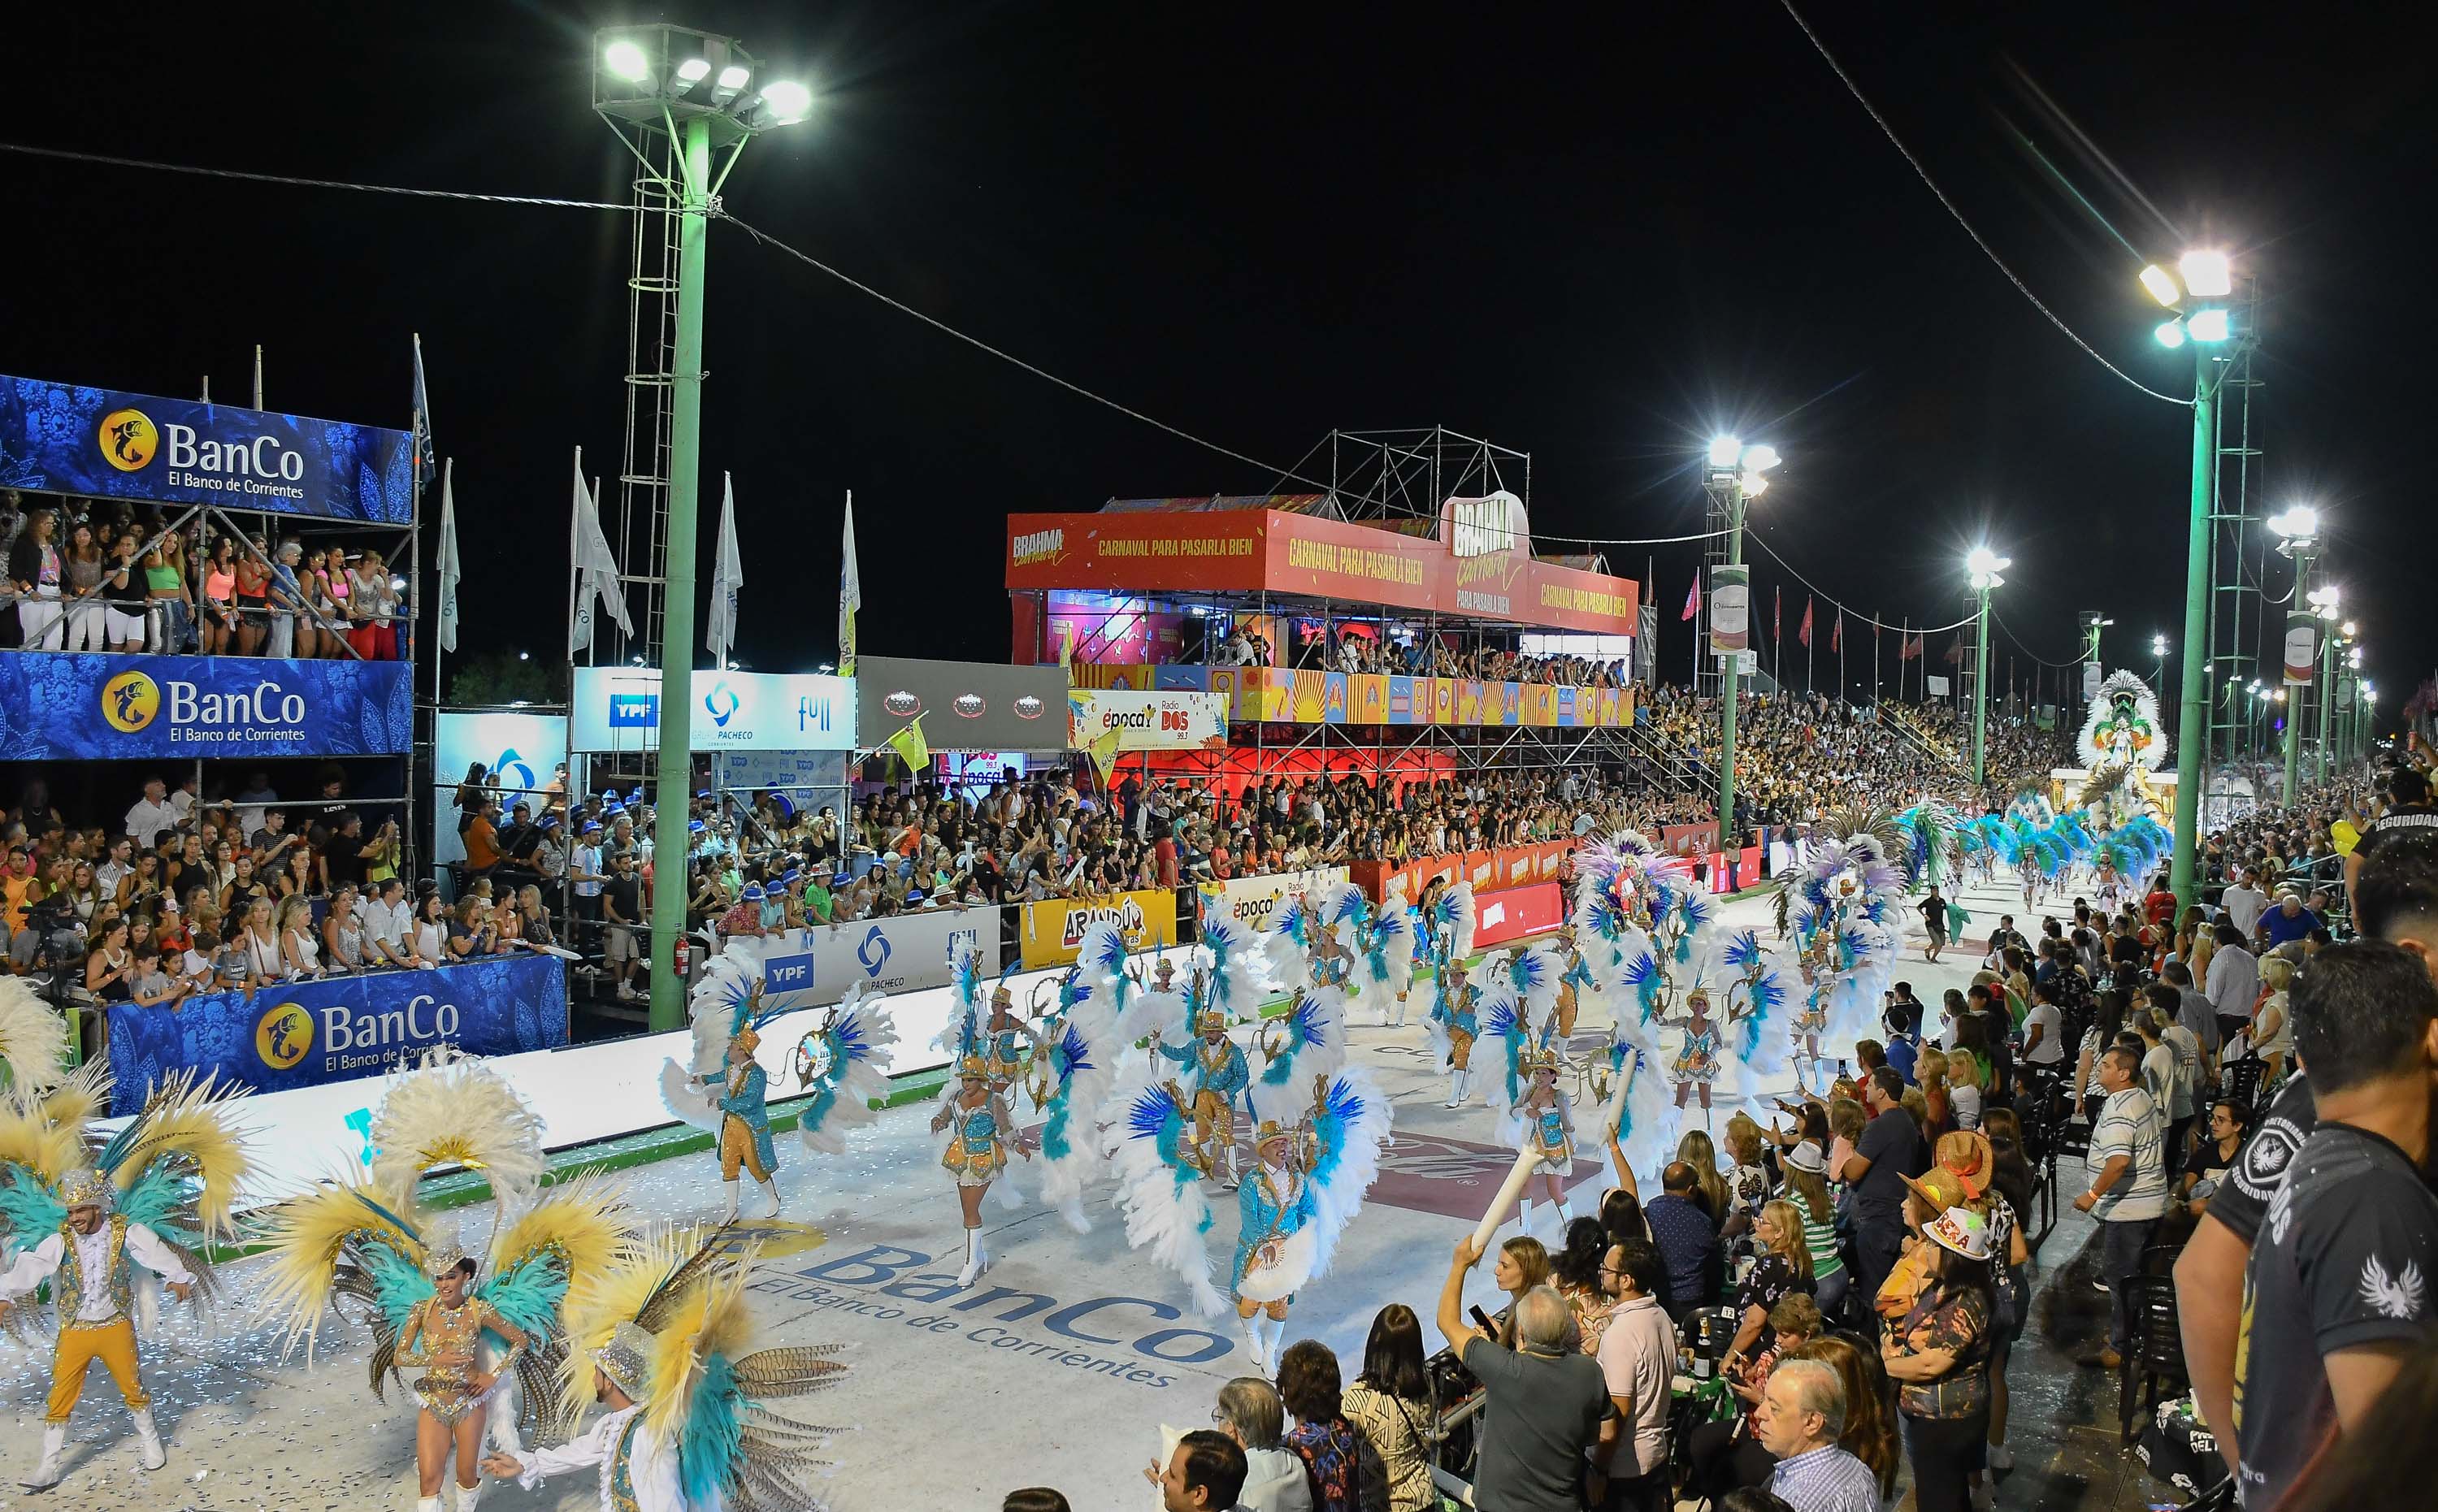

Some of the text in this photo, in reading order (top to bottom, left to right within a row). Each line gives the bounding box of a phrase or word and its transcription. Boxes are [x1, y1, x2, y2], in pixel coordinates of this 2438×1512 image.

[165, 423, 304, 481] BanCo
[169, 471, 304, 499] El Banco de Corrientes
[1450, 499, 1515, 557] BRAHMA
[1013, 528, 1063, 558] BRAHMA
[1099, 538, 1253, 557] CARNAVAL PARA PASARLA BIEN
[1289, 538, 1423, 586] CARNAVAL PARA PASARLA BIEN
[1456, 589, 1473, 610] PARA
[1473, 591, 1497, 613] PASARLA
[1541, 583, 1627, 618] CARNAVAL PARA PASARLA BIEN
[167, 681, 306, 724] BanCo
[617, 704, 651, 718] YPF
[1161, 700, 1179, 710] Radio
[1102, 707, 1145, 731] época
[1160, 710, 1189, 731] DOS
[171, 727, 306, 742] El Banco de Corrientes
[718, 730, 753, 740] PACHECO
[1177, 731, 1188, 740] 99.3
[1288, 882, 1304, 893] Radio
[1233, 896, 1273, 921] época
[773, 964, 806, 982] YPF
[870, 977, 904, 990] PACHECO
[320, 994, 459, 1053] BanCo
[326, 1056, 336, 1072] El
[341, 1054, 380, 1070] Banco
[383, 1049, 397, 1063] de
[795, 1243, 1235, 1363] BanCo
[1725, 1310, 1733, 1318] 12
[753, 1278, 1178, 1388] El Banco de Corrientes
